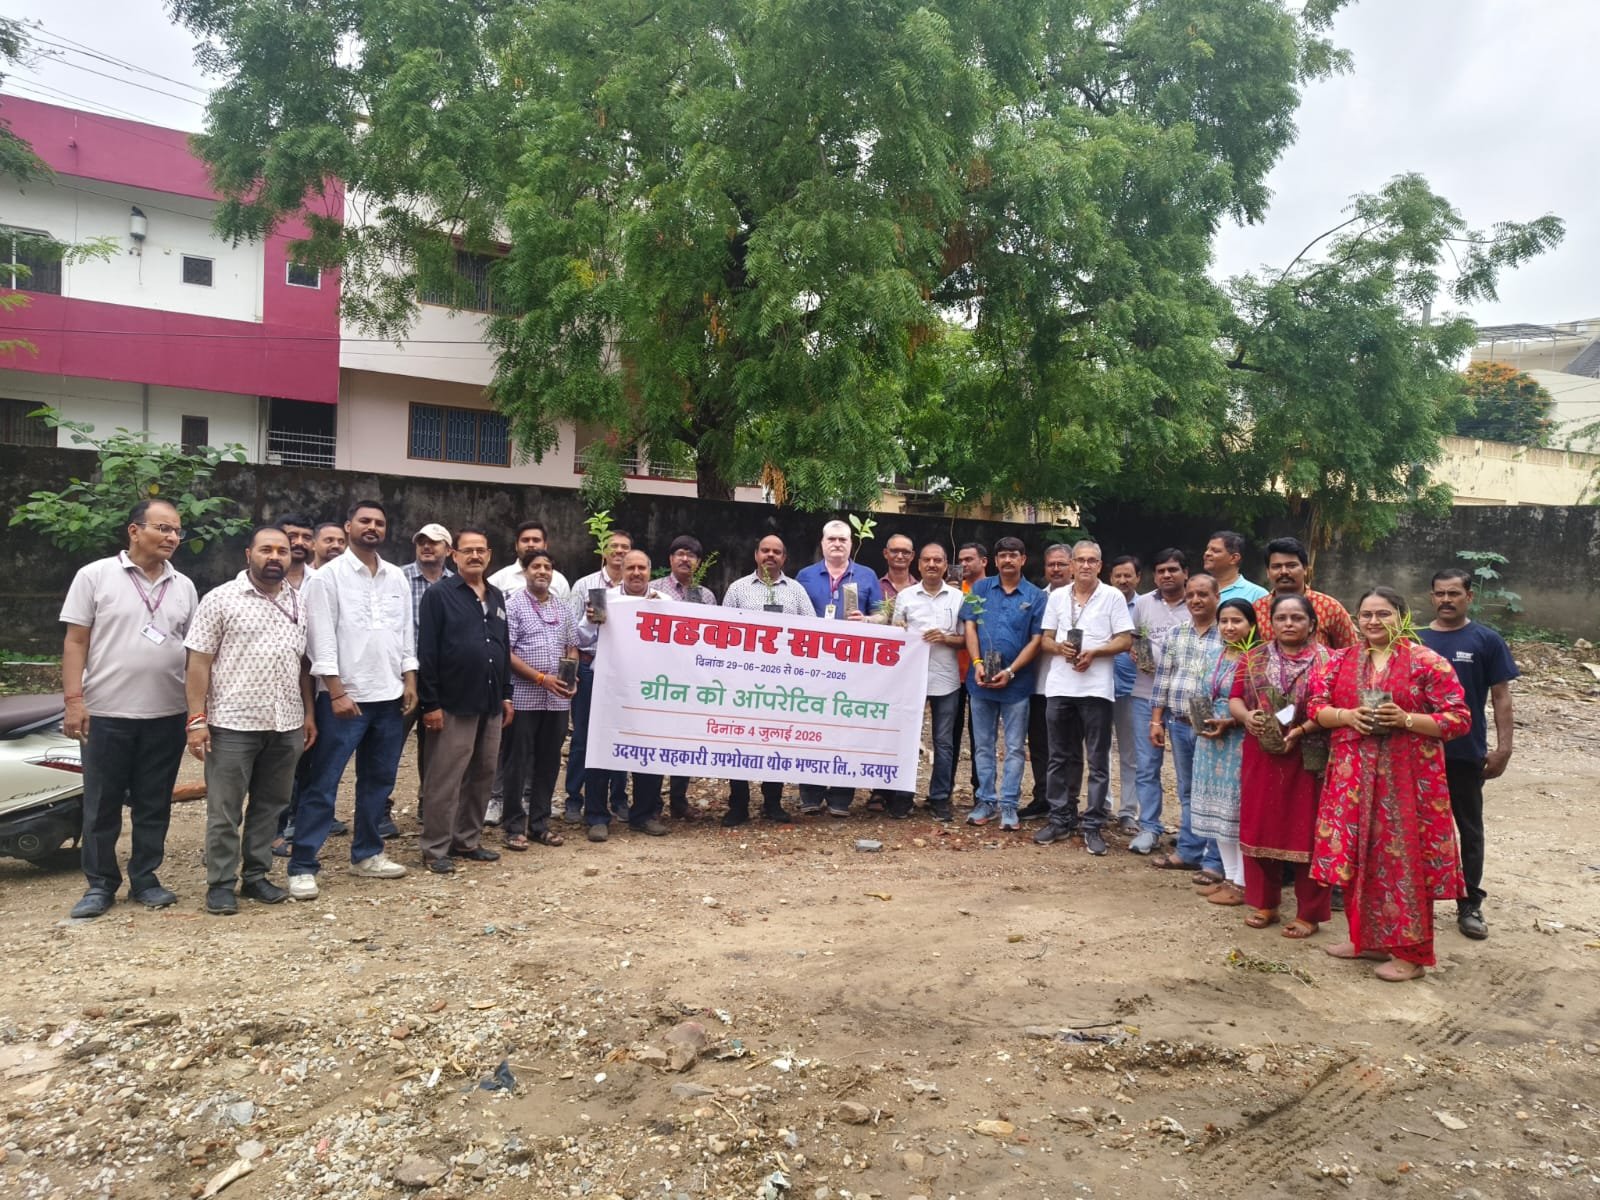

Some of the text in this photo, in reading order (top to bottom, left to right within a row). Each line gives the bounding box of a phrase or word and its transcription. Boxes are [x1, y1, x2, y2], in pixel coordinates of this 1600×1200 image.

[636, 611, 906, 667] सहकार सप्ताह
[695, 654, 847, 680] दिनांक 29-06-2026 से 06-07-2026
[640, 674, 890, 720] ग्रीन को ऑपरेटिव दिवस
[707, 718, 823, 742] दिनांक 4 जुलाई 2026
[612, 743, 656, 767] उदयपुर
[659, 746, 708, 767] सहकारी
[710, 748, 764, 769] उपभोक्ता
[767, 751, 793, 771] थोक
[795, 757, 831, 774] भण्डार
[860, 763, 899, 784] उदयपुर
